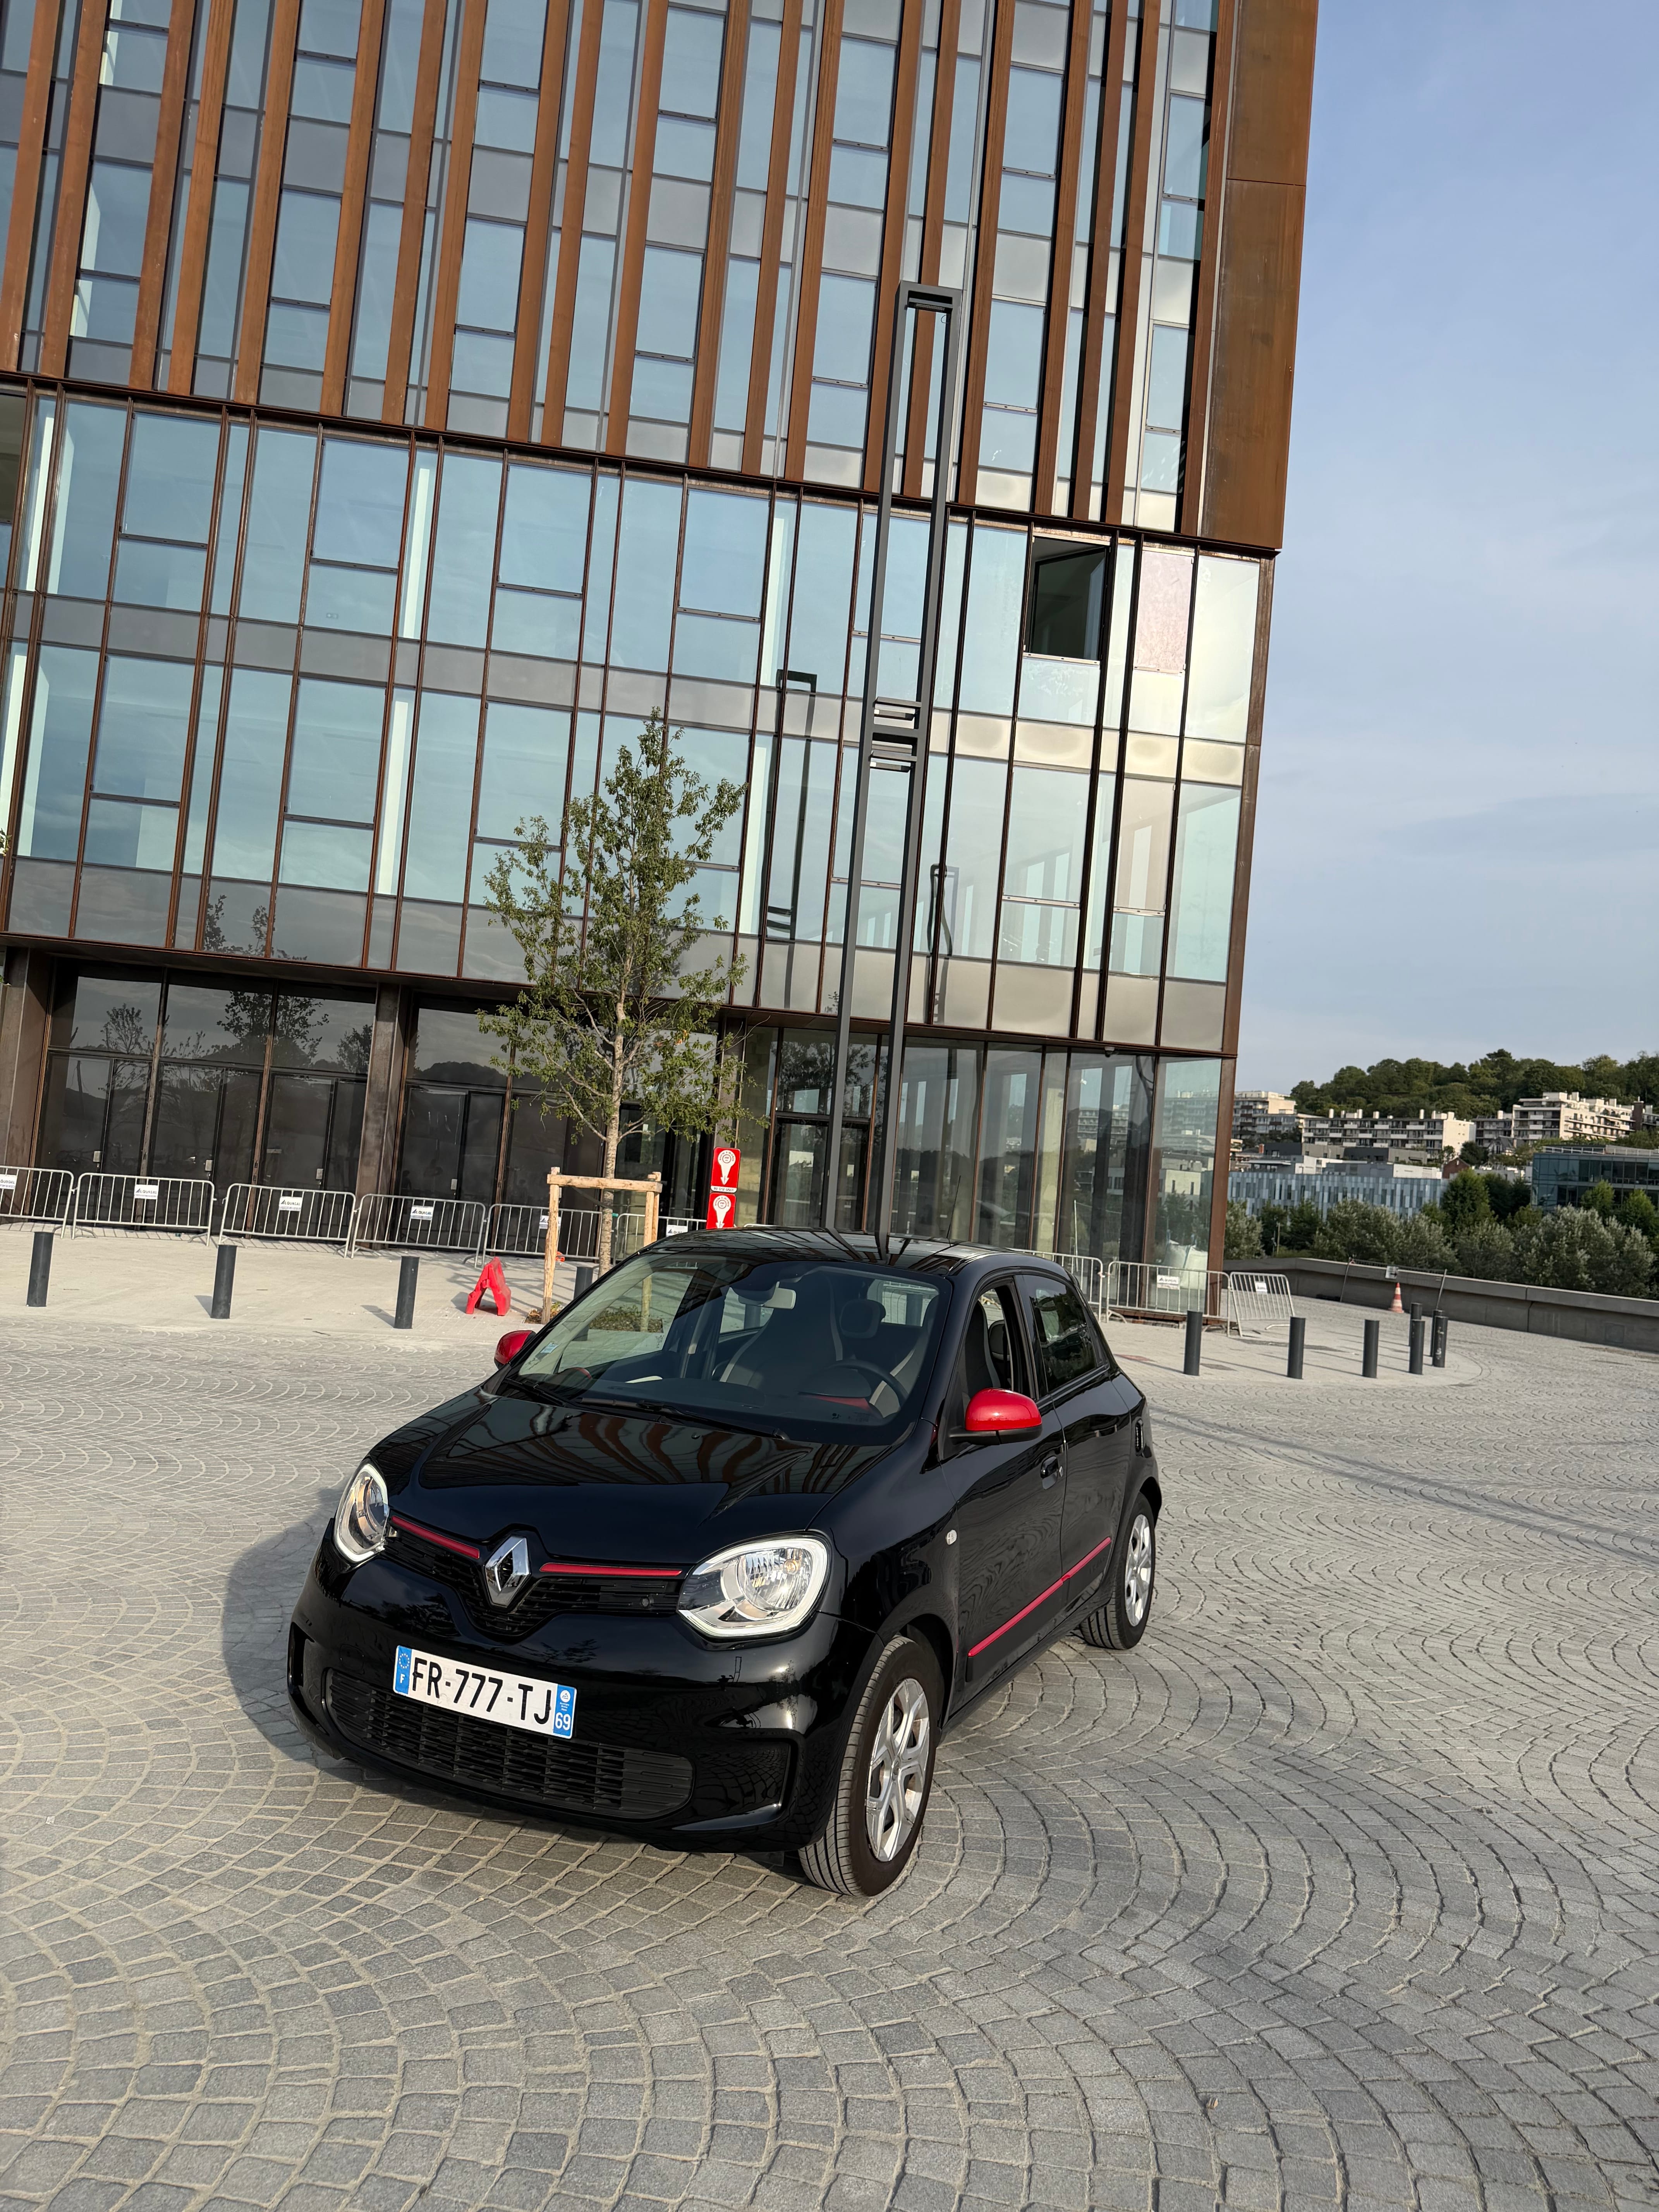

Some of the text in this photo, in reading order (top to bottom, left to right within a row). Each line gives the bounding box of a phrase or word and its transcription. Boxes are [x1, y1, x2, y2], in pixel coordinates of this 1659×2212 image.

[400, 1673, 405, 1683] F
[412, 1657, 552, 1724] FR-777-TJ
[555, 1712, 571, 1731] 69
